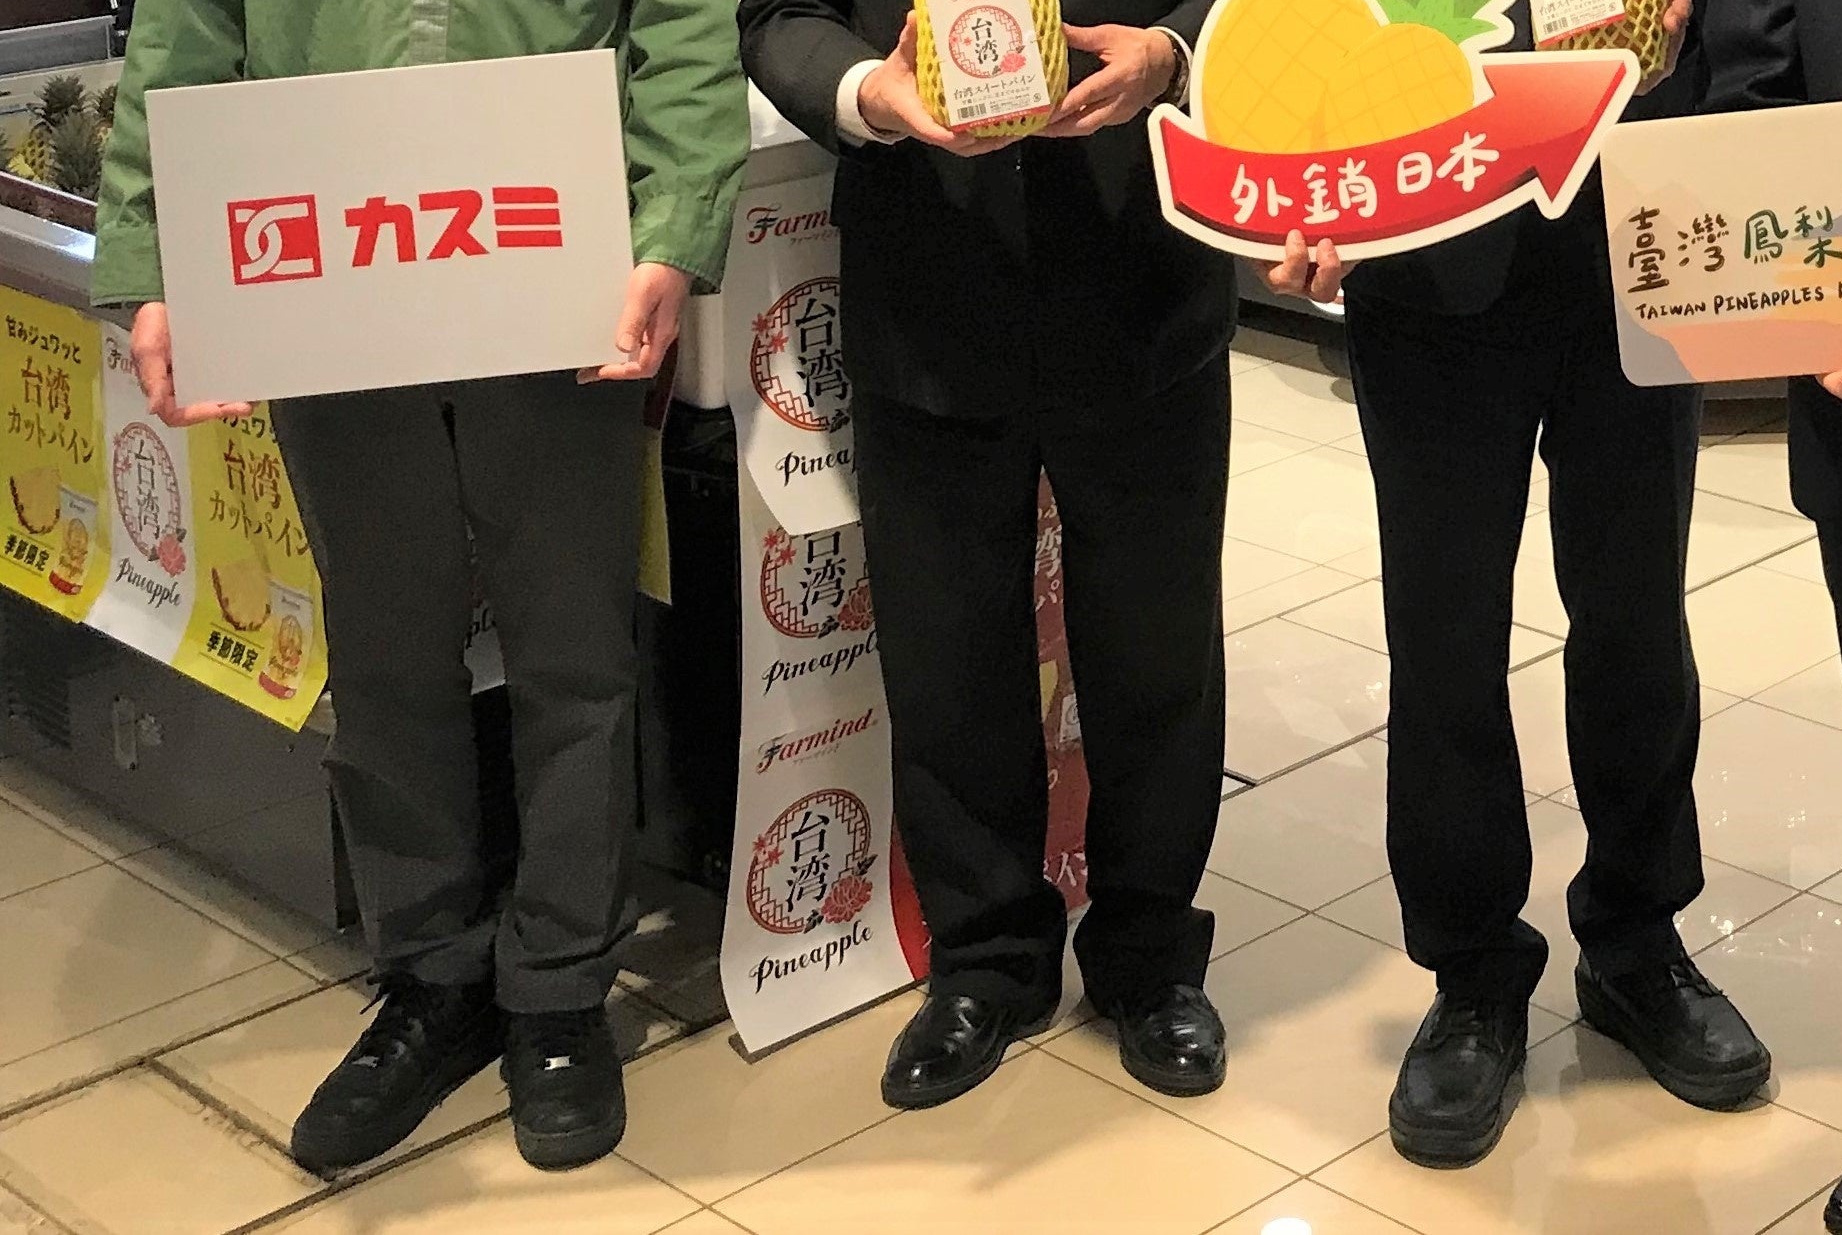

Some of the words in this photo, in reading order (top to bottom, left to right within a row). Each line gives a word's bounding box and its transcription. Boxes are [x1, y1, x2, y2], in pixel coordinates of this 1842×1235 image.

[971, 17, 1000, 65] 台湾
[952, 72, 1037, 102] 台湾スイートパイン
[1230, 130, 1500, 226] 外銷日本
[345, 187, 563, 268] カスミ
[1635, 300, 1707, 321] TAIWAN
[1713, 284, 1825, 316] PINEAPPLES
[795, 297, 852, 408] 台湾
[20, 355, 72, 421] 台湾
[7, 406, 95, 465] カットパイン
[132, 439, 162, 541] 台湾
[223, 438, 283, 511] 台湾
[4, 533, 51, 573] 季節限定
[209, 488, 311, 559] カットパイン
[115, 556, 182, 610] Pineapple
[205, 628, 261, 673] 季節限定
[754, 707, 876, 776] Farmind
[786, 810, 832, 913] 台湾
[748, 919, 874, 995] Pineapple
